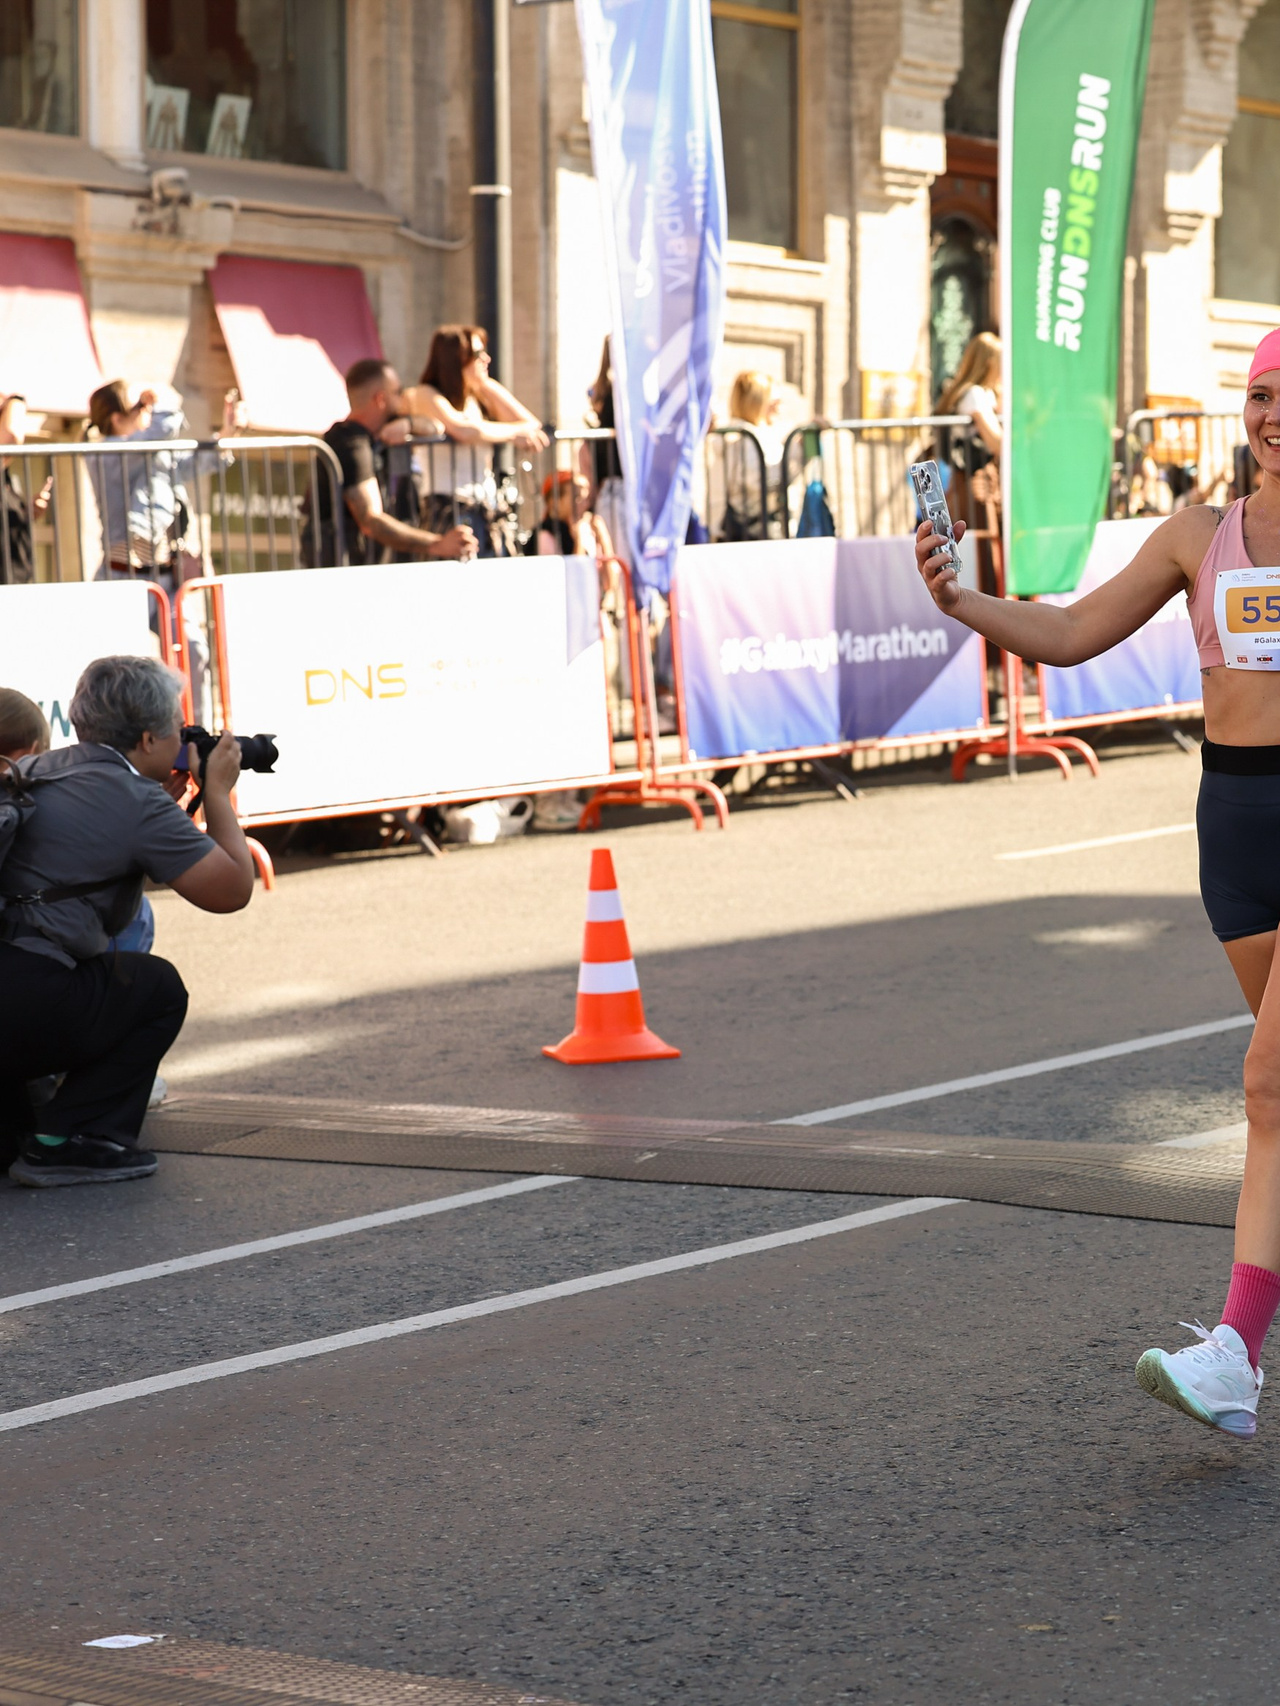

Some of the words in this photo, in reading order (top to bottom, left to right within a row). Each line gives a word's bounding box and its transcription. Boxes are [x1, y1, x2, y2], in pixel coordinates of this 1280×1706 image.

[1040, 187, 1062, 242] CLUB
[719, 622, 949, 675] #GalaxyMarathon
[305, 662, 407, 706] DNS
